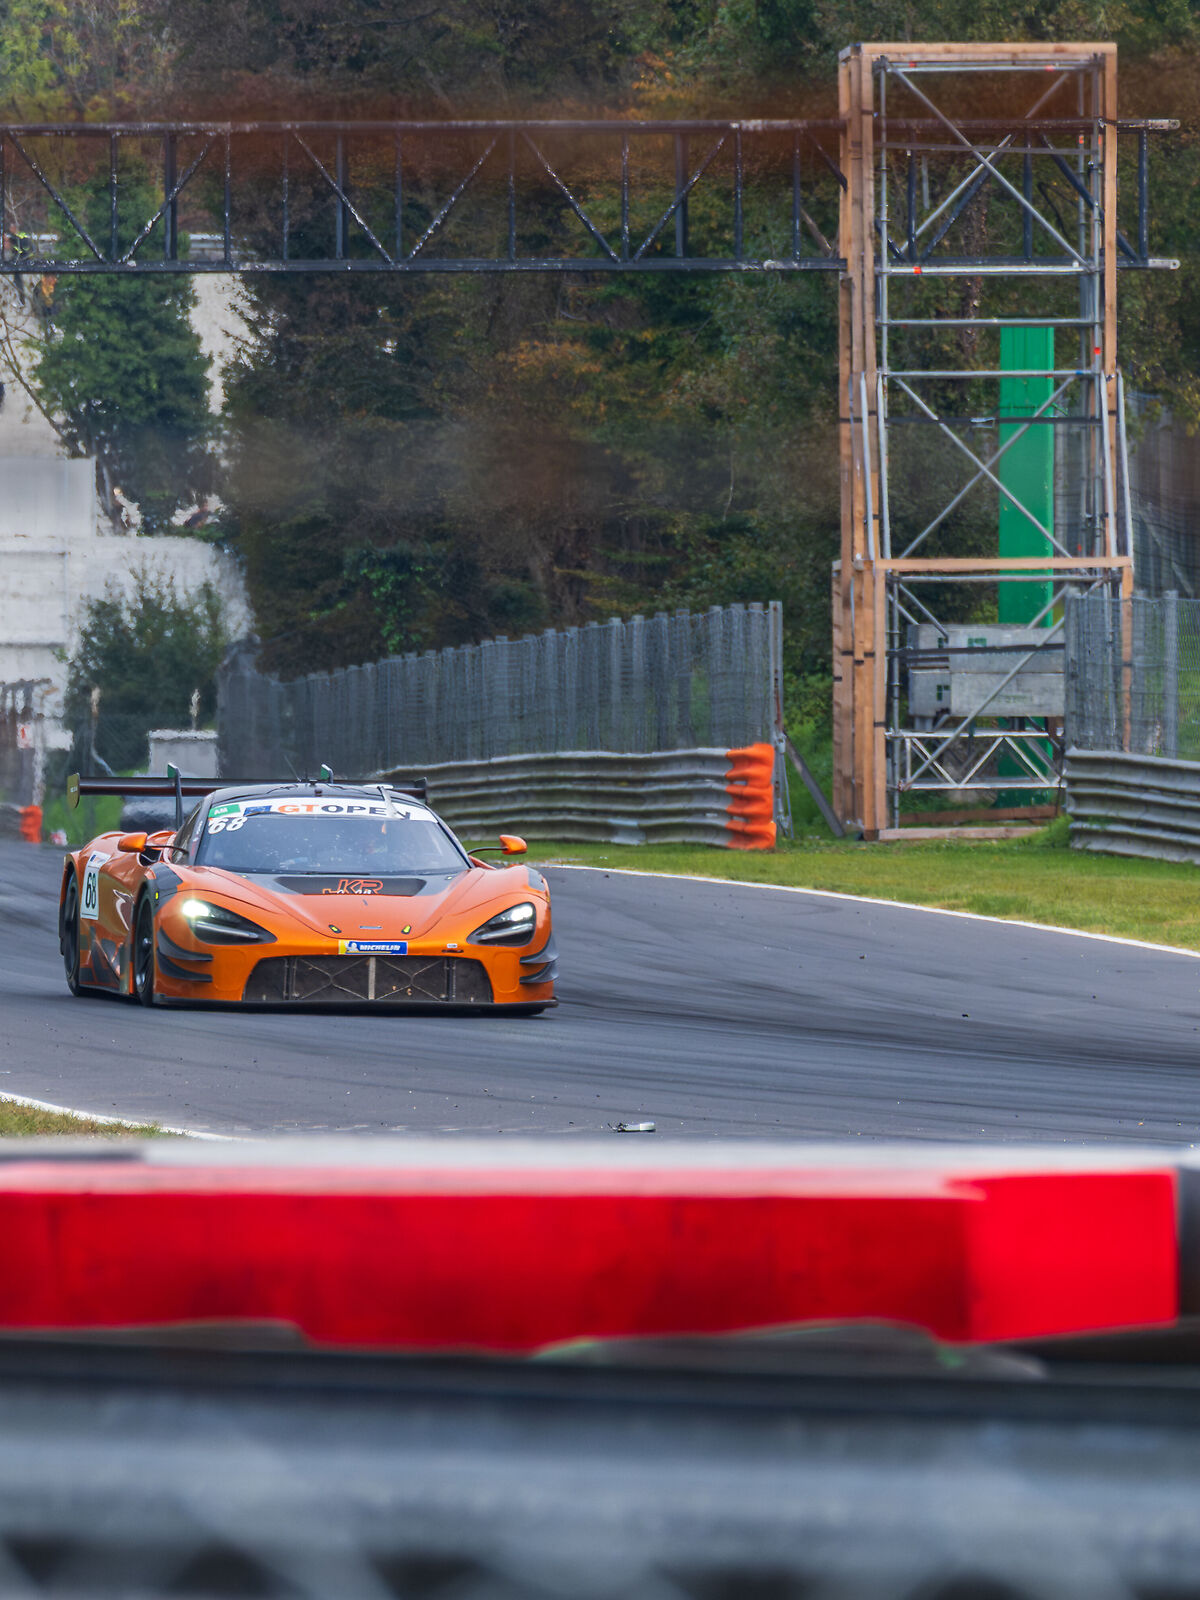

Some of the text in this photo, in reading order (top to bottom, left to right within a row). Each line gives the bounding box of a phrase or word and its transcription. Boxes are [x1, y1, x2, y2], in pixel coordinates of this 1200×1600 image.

[214, 807, 228, 815] AM
[208, 817, 248, 834] 68
[85, 872, 97, 909] 68
